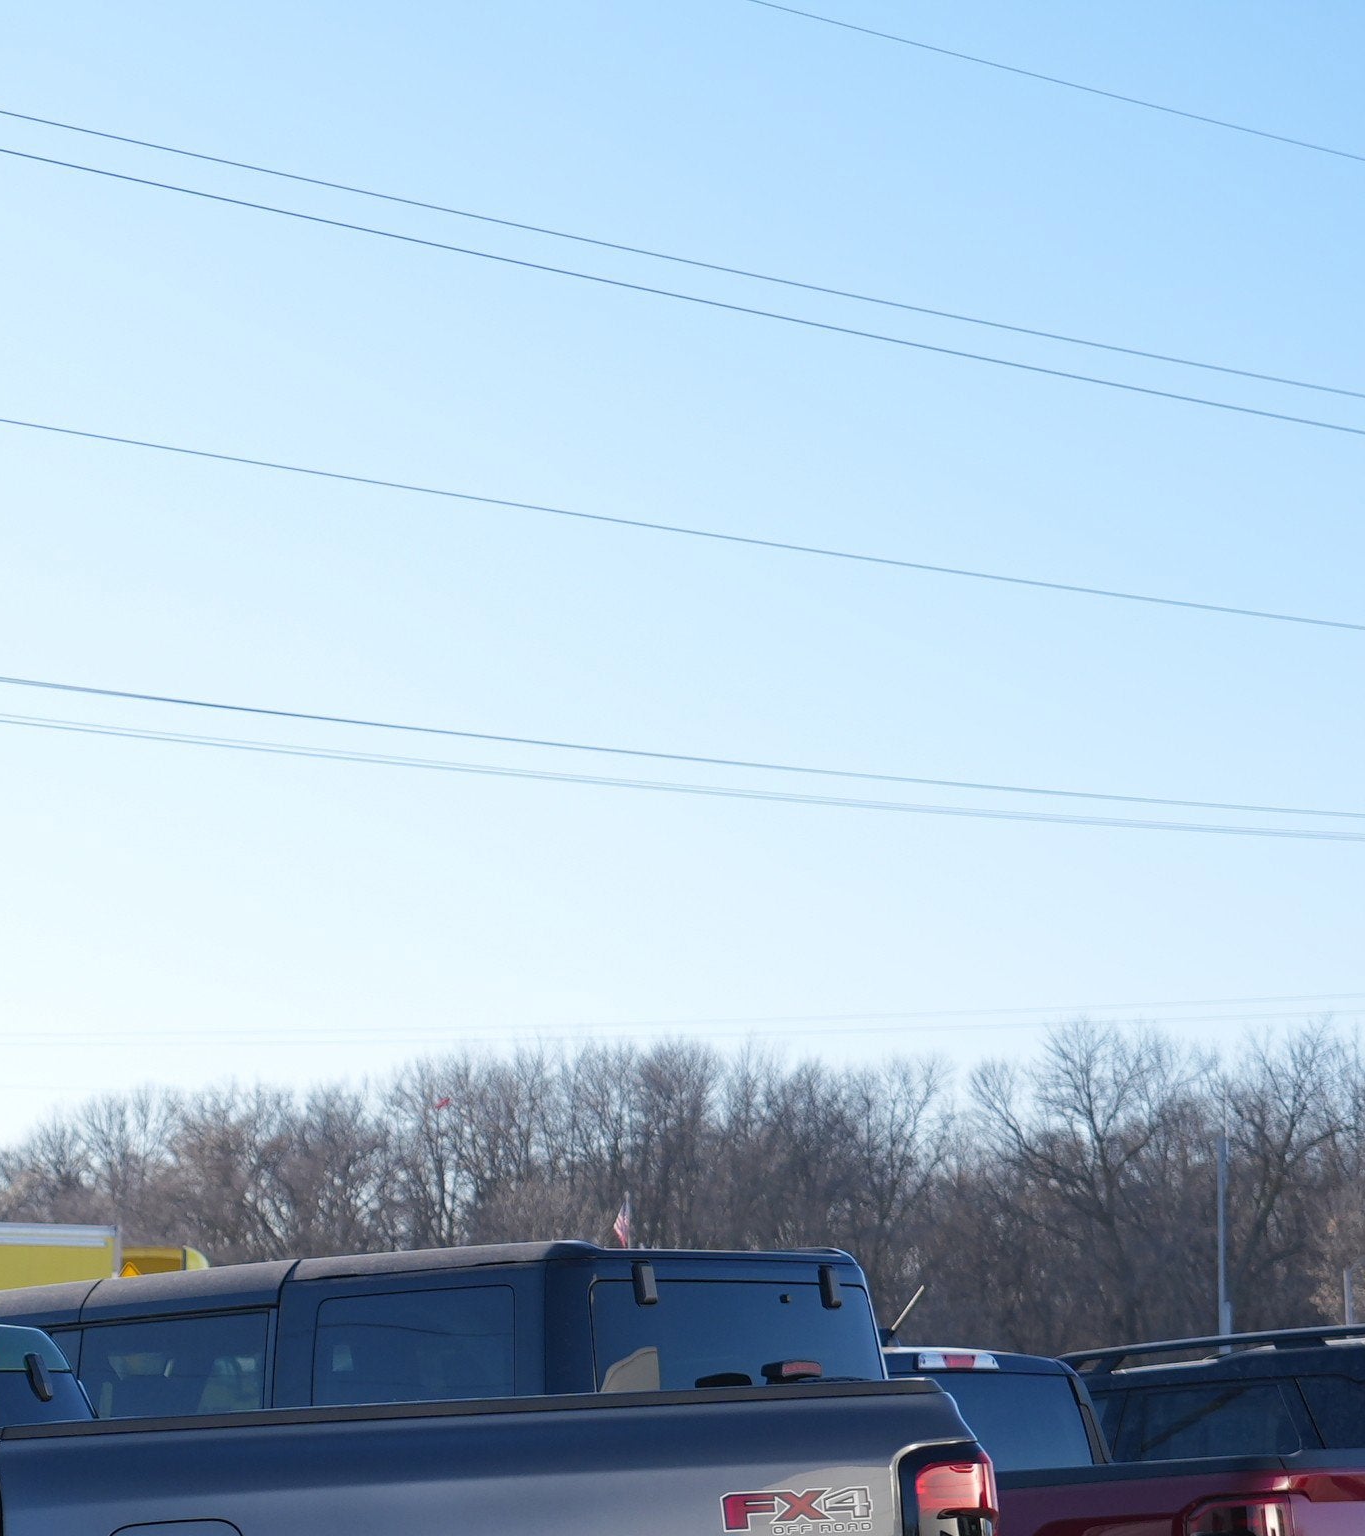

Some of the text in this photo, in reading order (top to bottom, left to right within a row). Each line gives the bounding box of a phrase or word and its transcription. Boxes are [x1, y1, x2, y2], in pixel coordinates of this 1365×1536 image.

[720, 1486, 873, 1532] FX4
[772, 1519, 873, 1536] OFF ROAD
